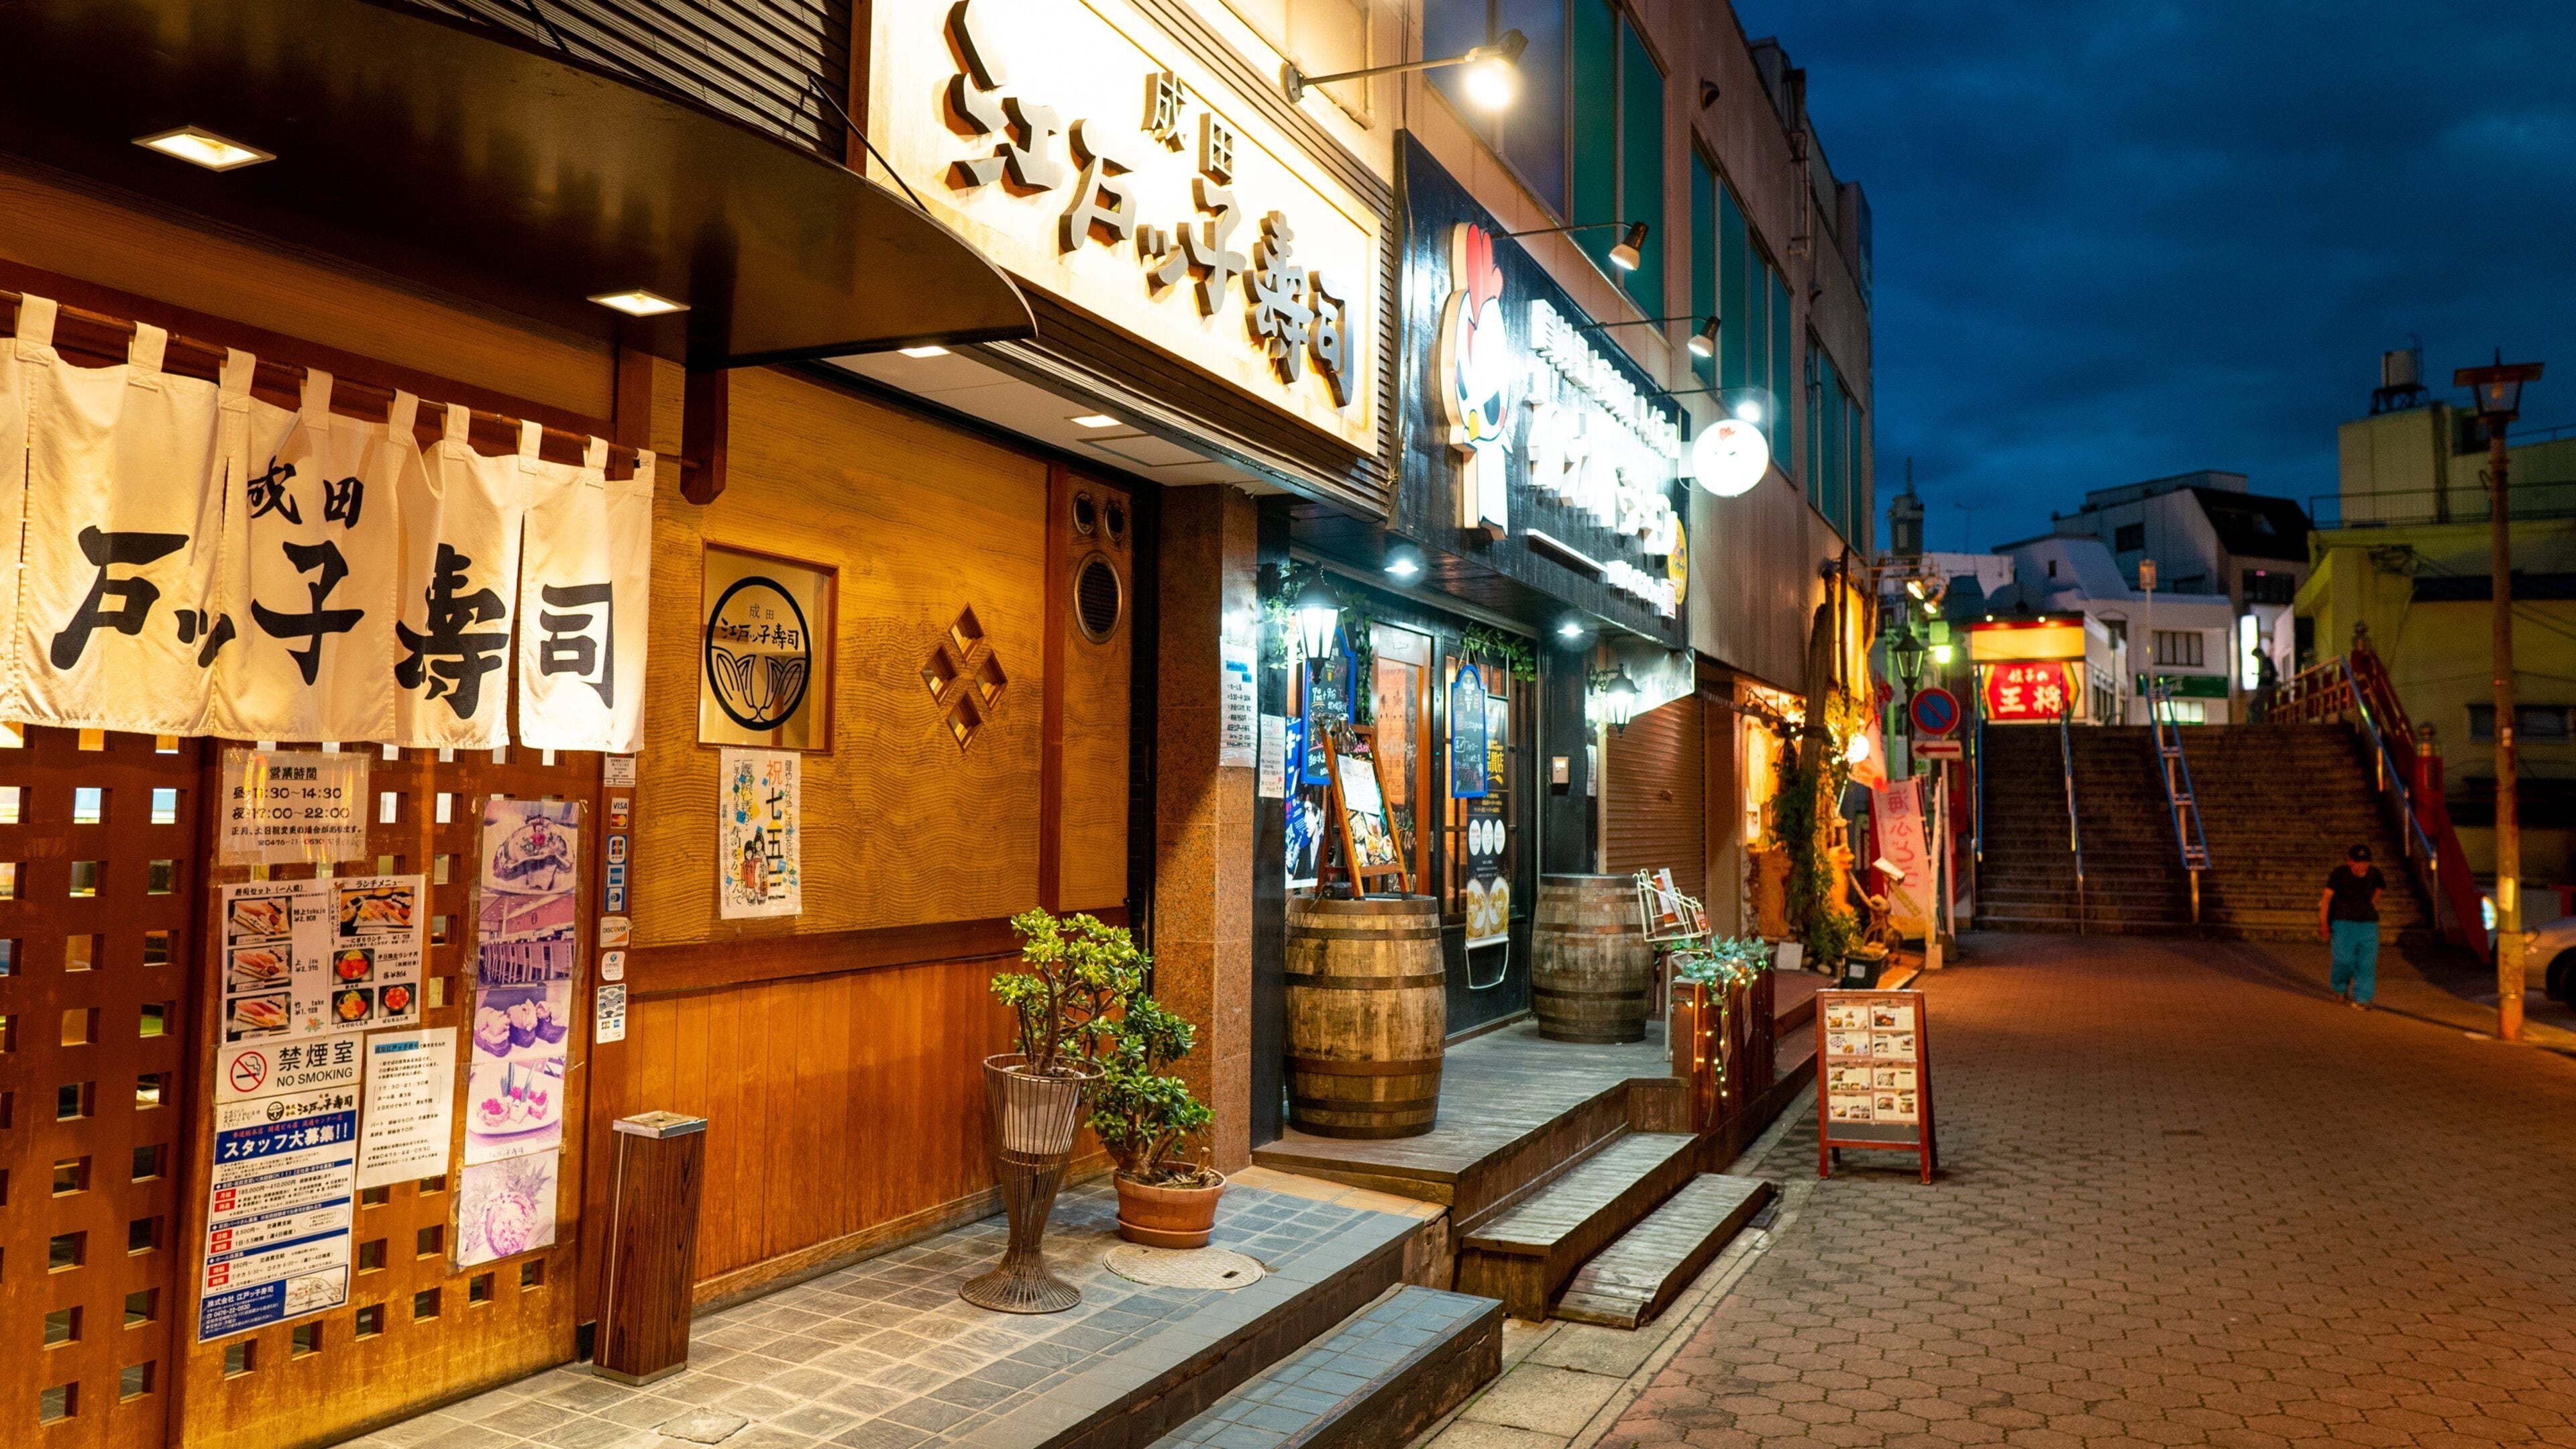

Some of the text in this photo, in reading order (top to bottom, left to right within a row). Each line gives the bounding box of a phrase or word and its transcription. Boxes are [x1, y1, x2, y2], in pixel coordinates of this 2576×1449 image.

[1142, 70, 1233, 186] 成田
[248, 455, 364, 529] 成田
[749, 604, 774, 620] 成田
[721, 618, 799, 650] 江戸ッ子寿司
[1998, 685, 2061, 714] 王将
[269, 767, 317, 780] 営業時間
[613, 802, 627, 810] VISA
[356, 879, 404, 888] ランチメニュー
[235, 886, 271, 896] 寿司セット
[603, 926, 627, 934] DISCOVER
[278, 1040, 354, 1071] 禁煙室
[276, 1067, 353, 1087] NO SMOKING
[220, 1191, 231, 1199] 月給
[267, 1220, 292, 1230] 交通費支給
[260, 1253, 285, 1263] 交通費支給
[207, 1295, 234, 1307] 株式会社
[236, 1285, 274, 1300] 江戸ッ子寿司
[214, 1303, 251, 1316] 0476-22-0530
